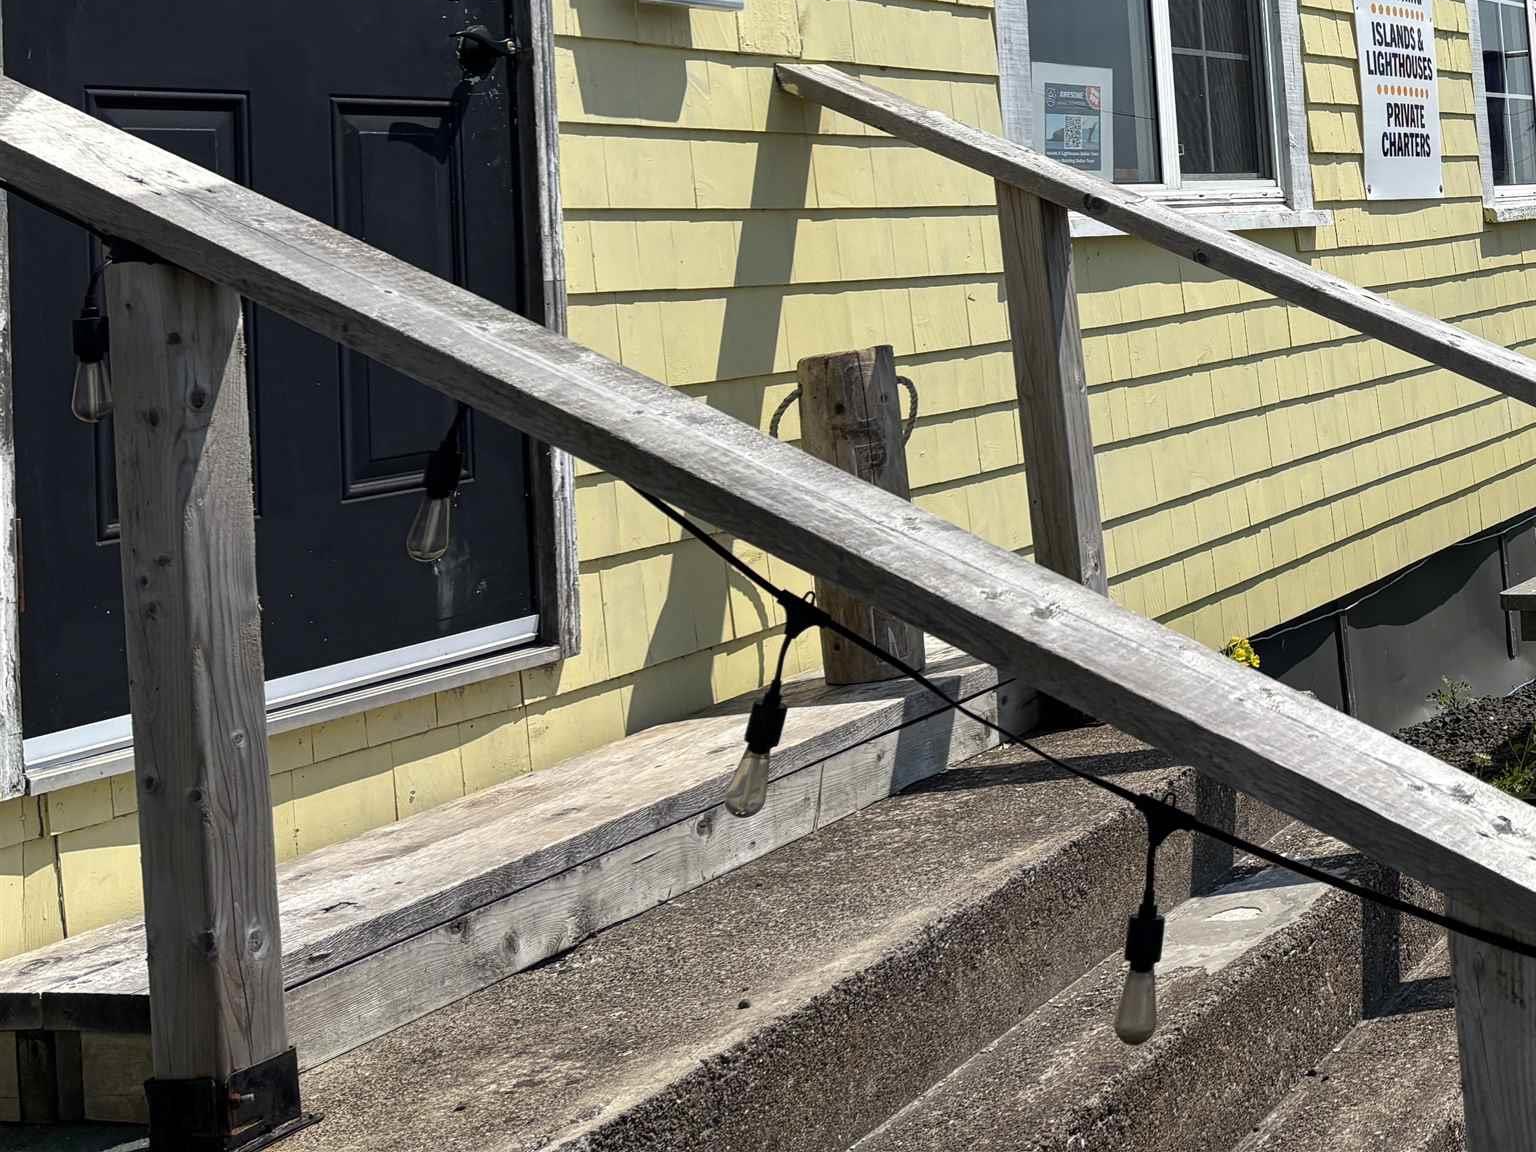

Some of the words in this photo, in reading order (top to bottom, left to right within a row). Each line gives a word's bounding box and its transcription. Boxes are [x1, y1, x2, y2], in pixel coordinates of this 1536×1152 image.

[1371, 21, 1416, 51] ISLANDS
[1417, 28, 1424, 52] &
[1366, 50, 1433, 81] LIGHTHOUSES
[1386, 102, 1425, 128] PRIVATE
[1381, 131, 1431, 157] CHARTERS
